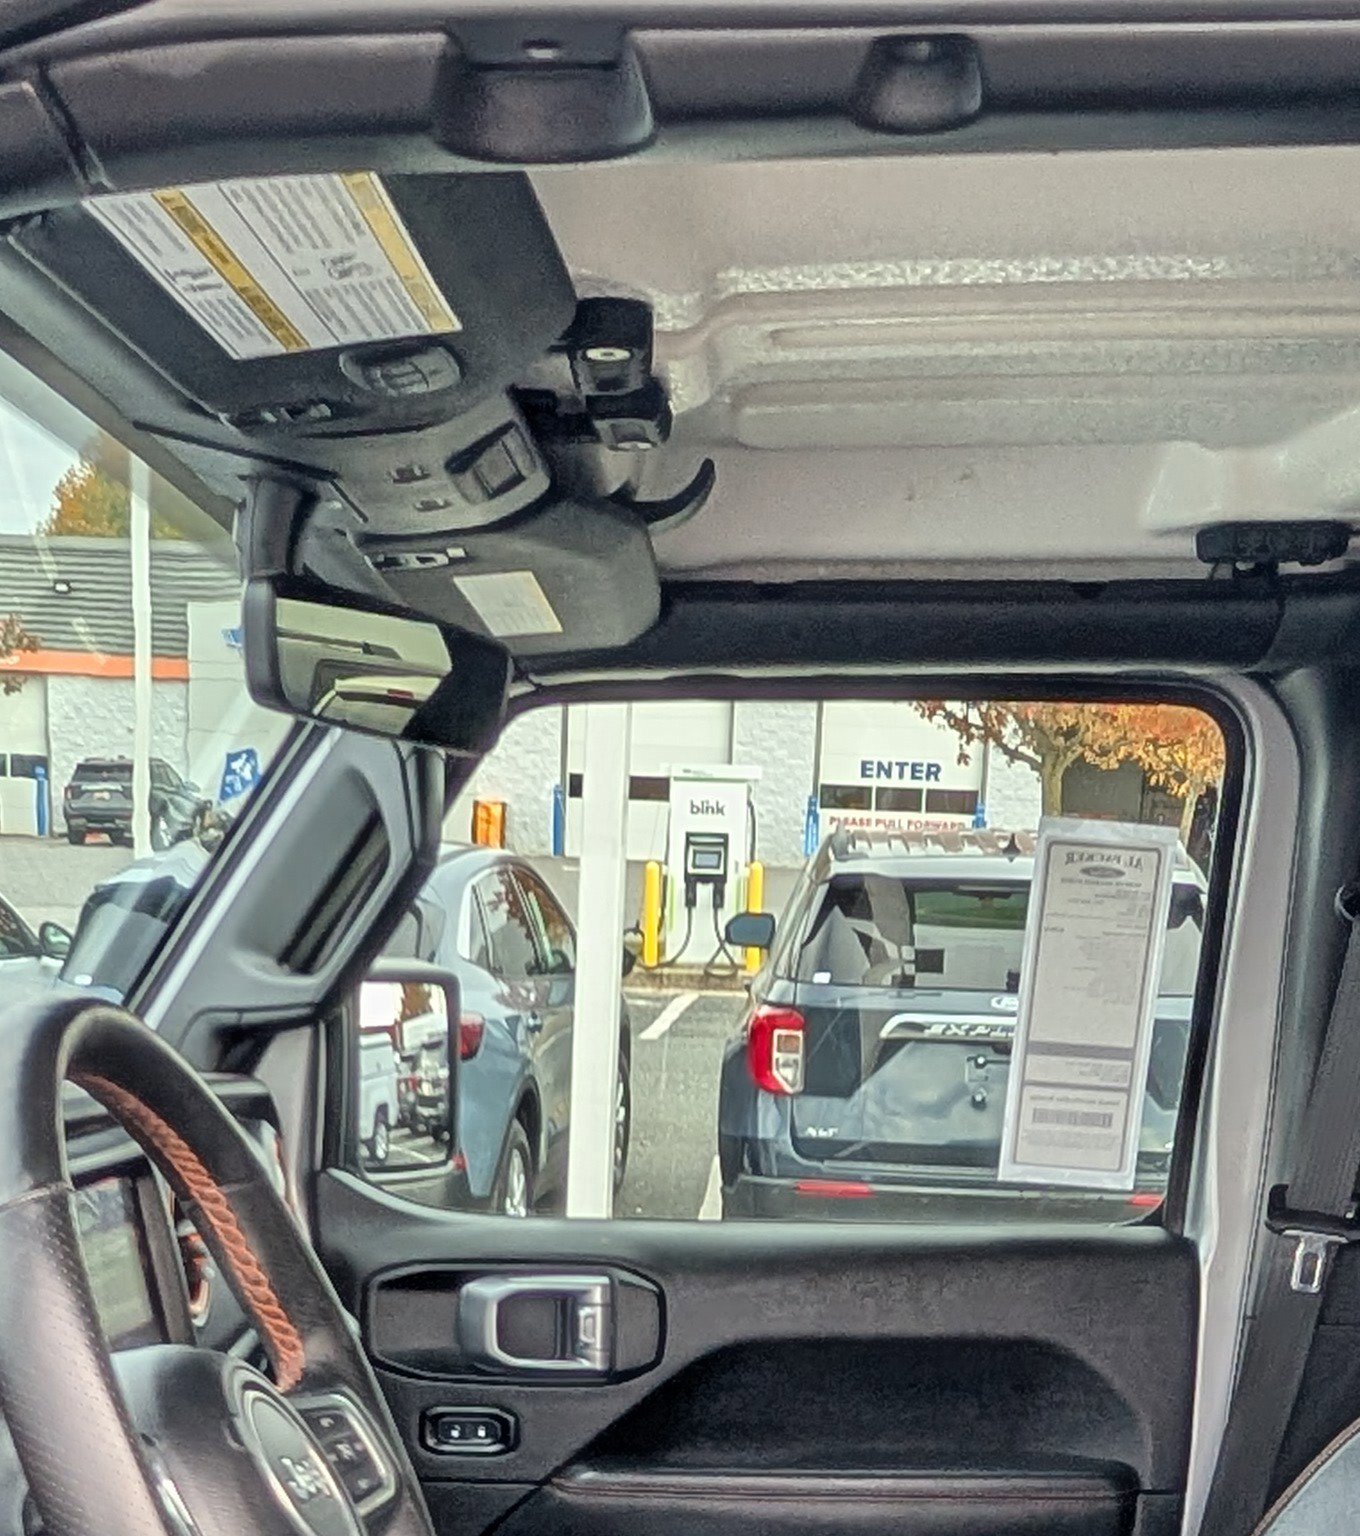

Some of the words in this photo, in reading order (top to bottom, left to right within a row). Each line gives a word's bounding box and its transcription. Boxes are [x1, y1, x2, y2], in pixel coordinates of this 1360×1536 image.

[859, 759, 942, 782] ENTER
[689, 800, 726, 816] blink
[828, 816, 872, 829] PLEASE
[923, 1023, 1016, 1036] EXPL
